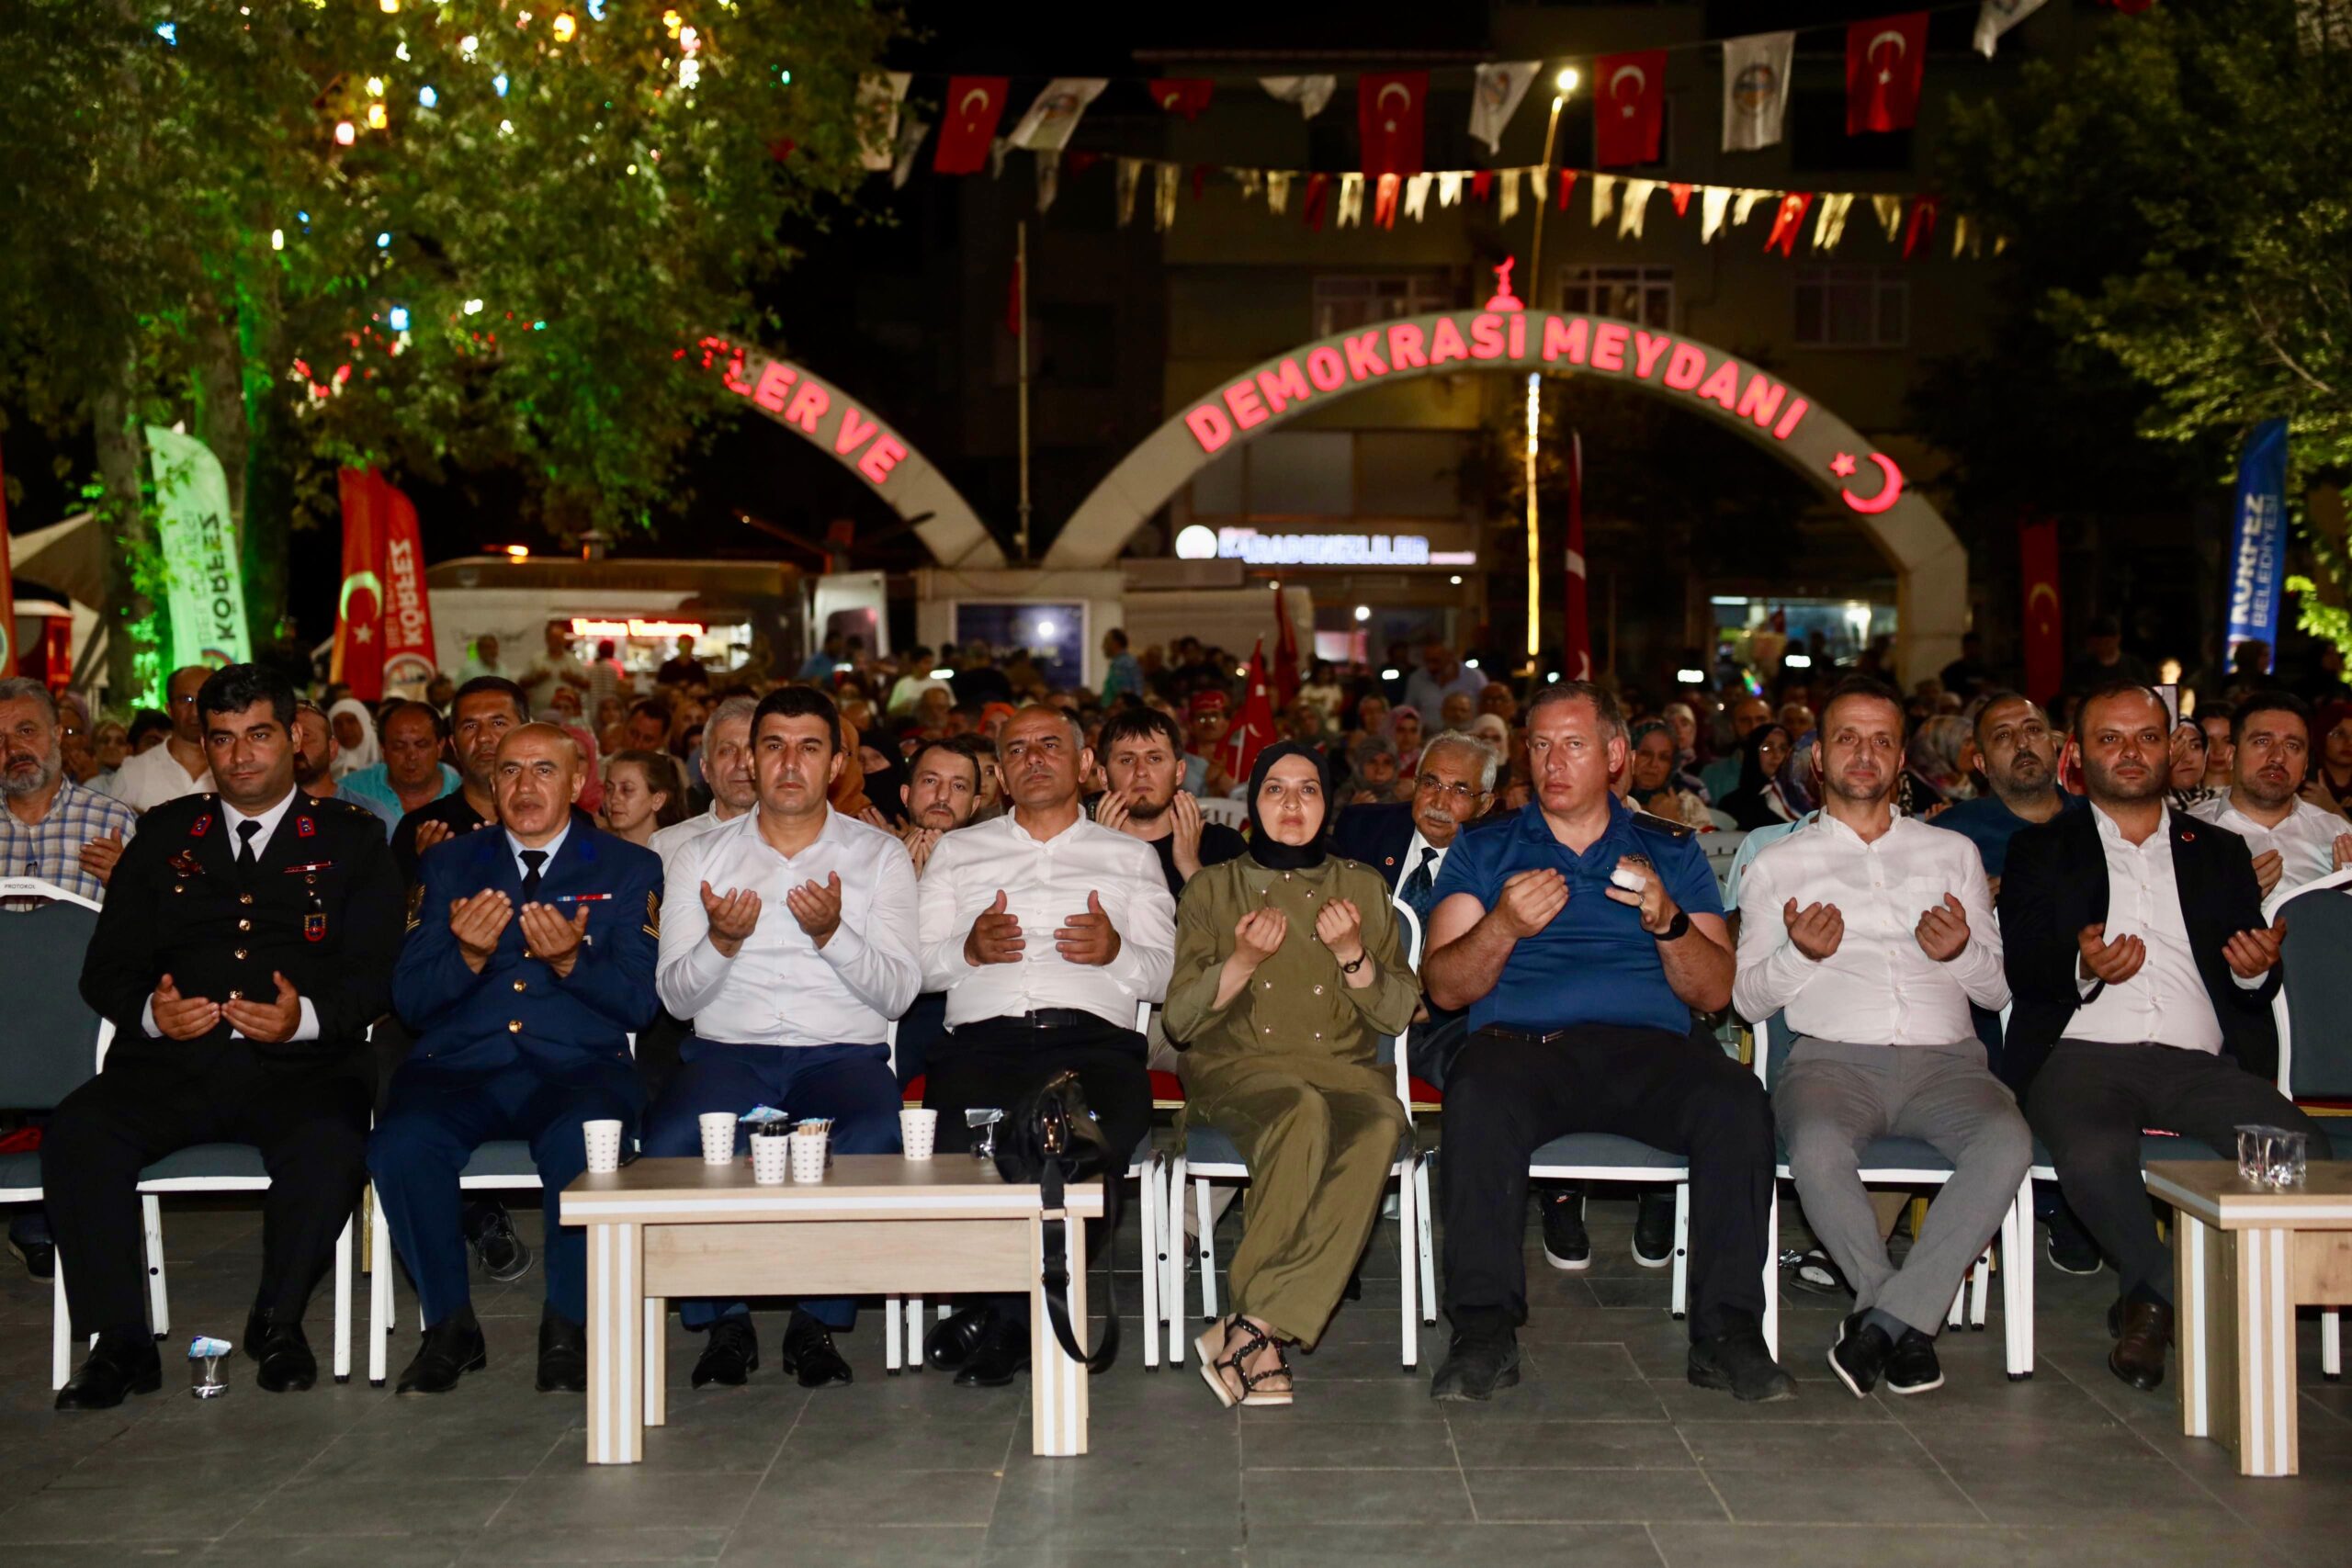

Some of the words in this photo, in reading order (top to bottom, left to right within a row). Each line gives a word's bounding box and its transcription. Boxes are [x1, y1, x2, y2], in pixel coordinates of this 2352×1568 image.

[1184, 312, 1526, 454] DEMOKRASİ
[1543, 314, 1810, 442] MEYDANI
[834, 406, 910, 485] VE
